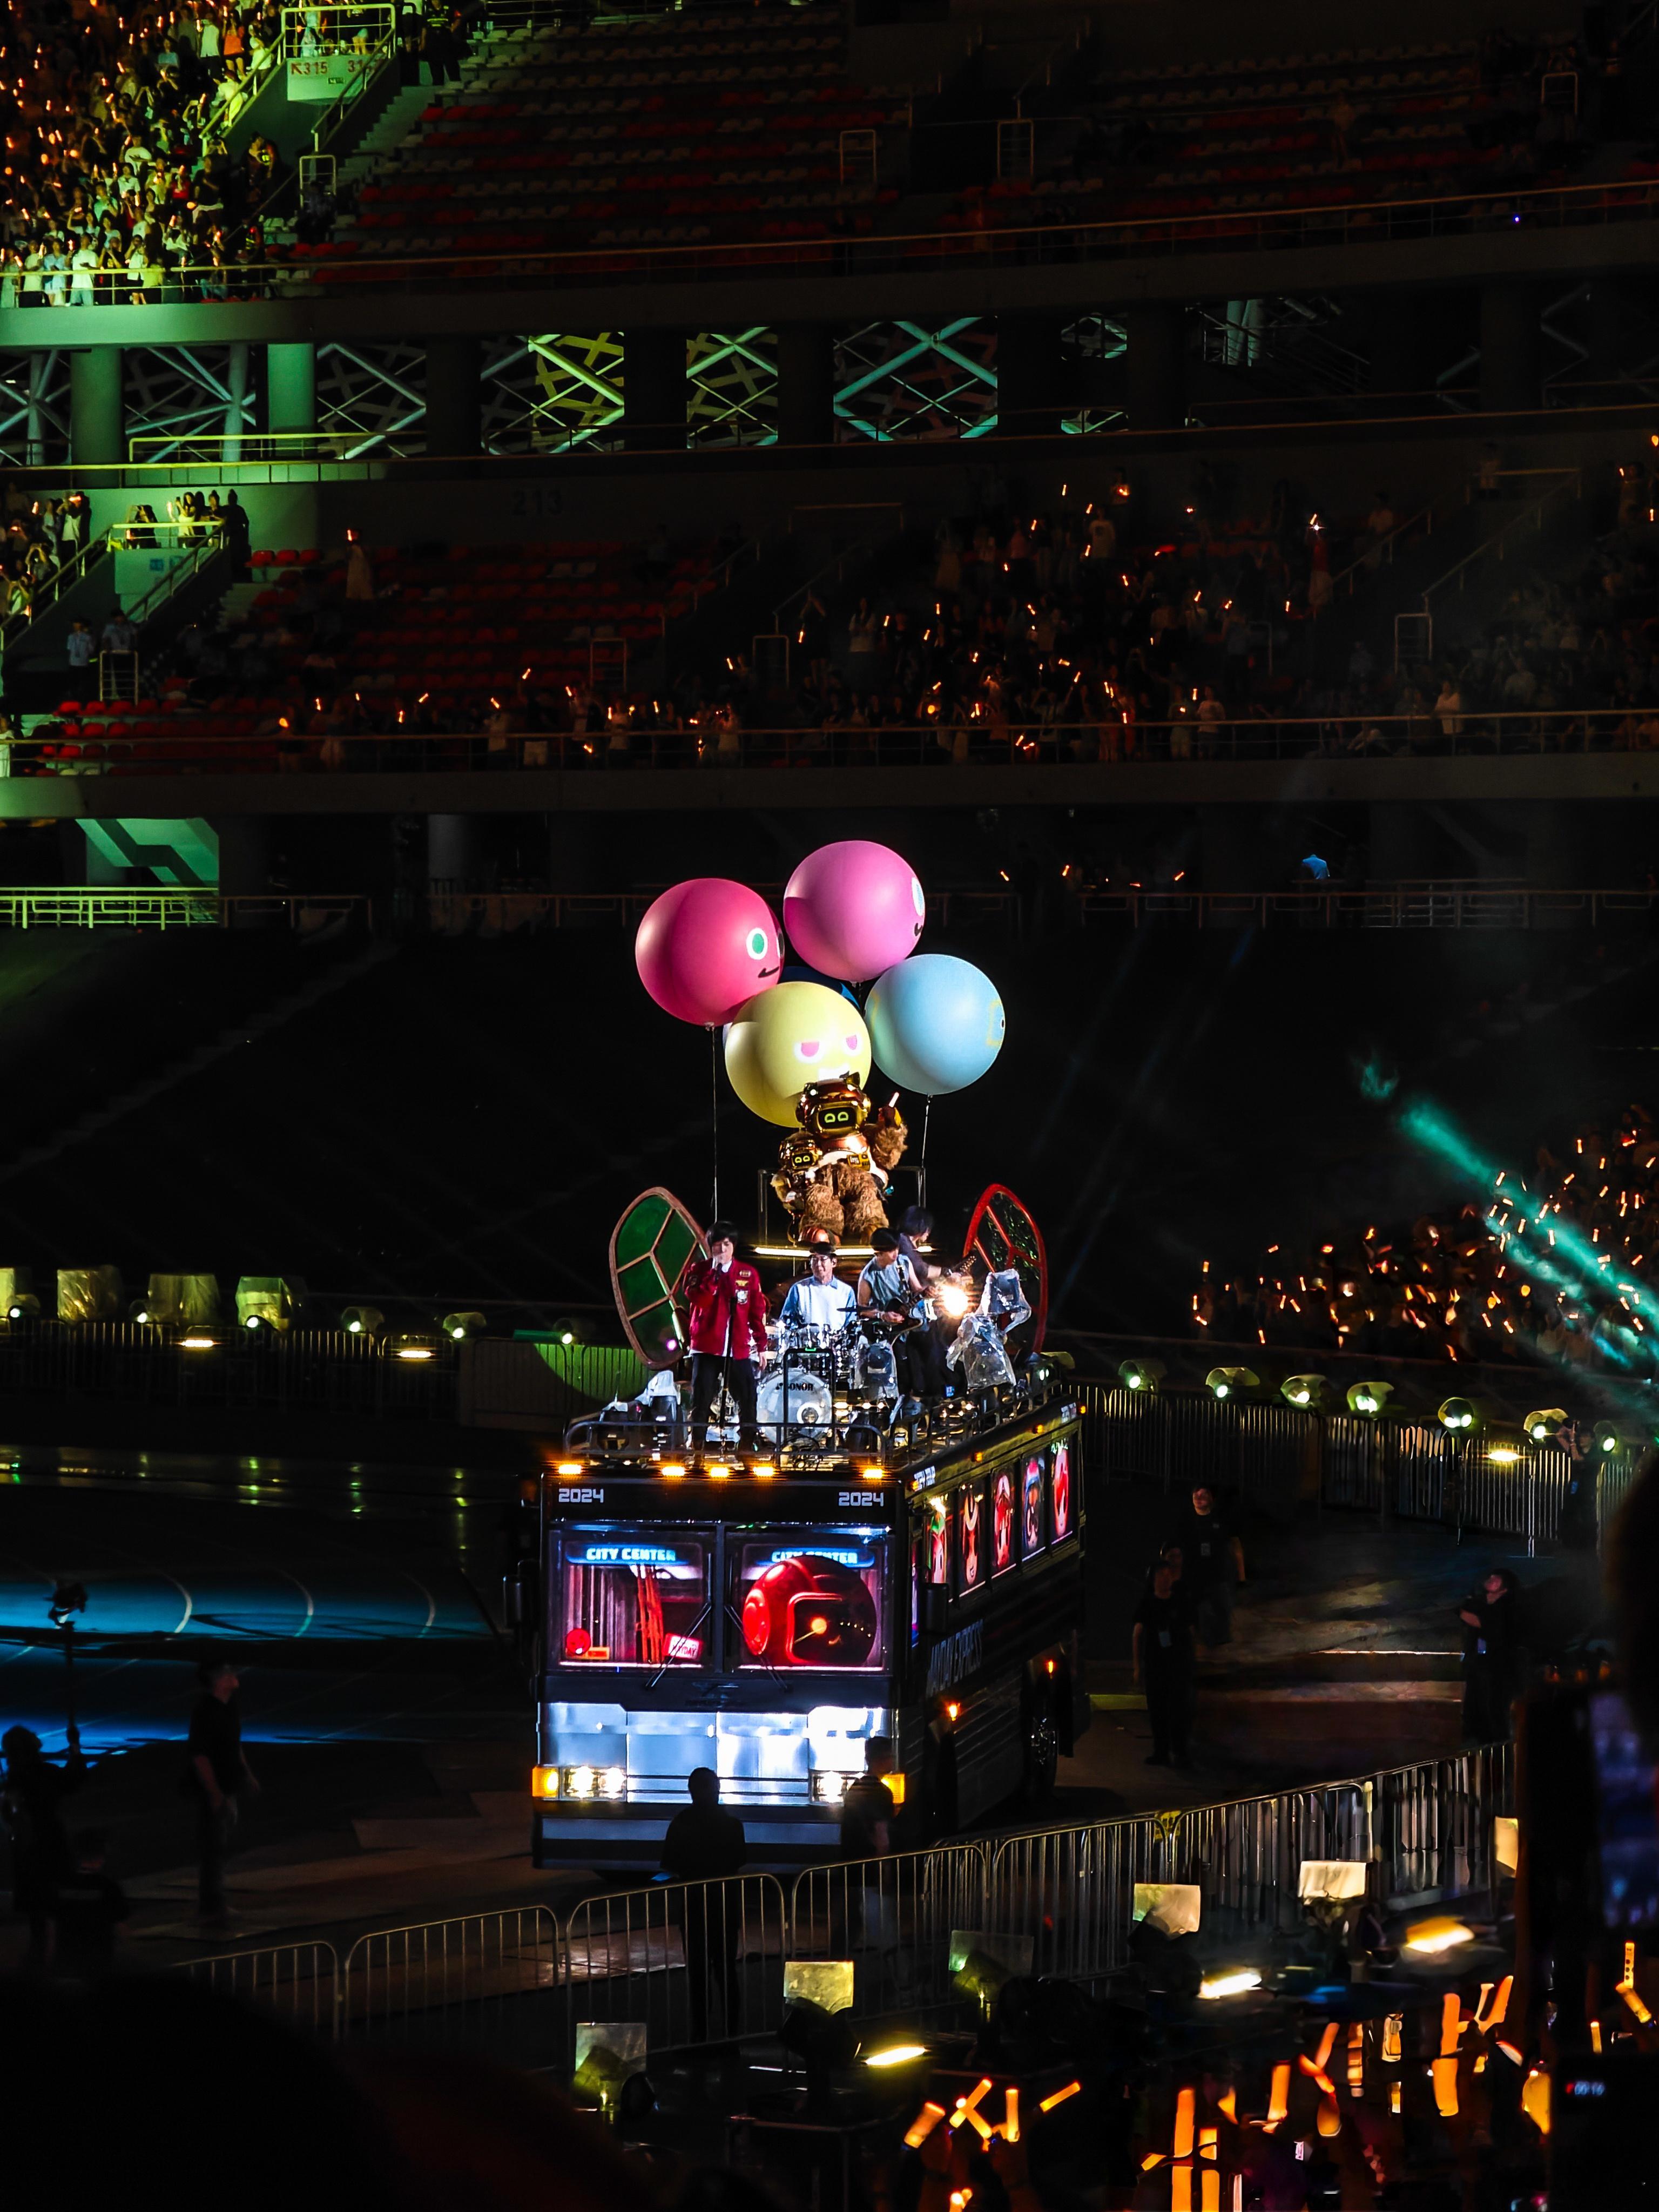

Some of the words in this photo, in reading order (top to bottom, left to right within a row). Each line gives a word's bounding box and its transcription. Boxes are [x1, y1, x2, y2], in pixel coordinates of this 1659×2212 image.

[784, 1382, 814, 1391] ONOR
[558, 1488, 604, 1503] 2024
[839, 1492, 884, 1507] 2024
[586, 1548, 618, 1560] CITY
[622, 1548, 676, 1561] CENTER
